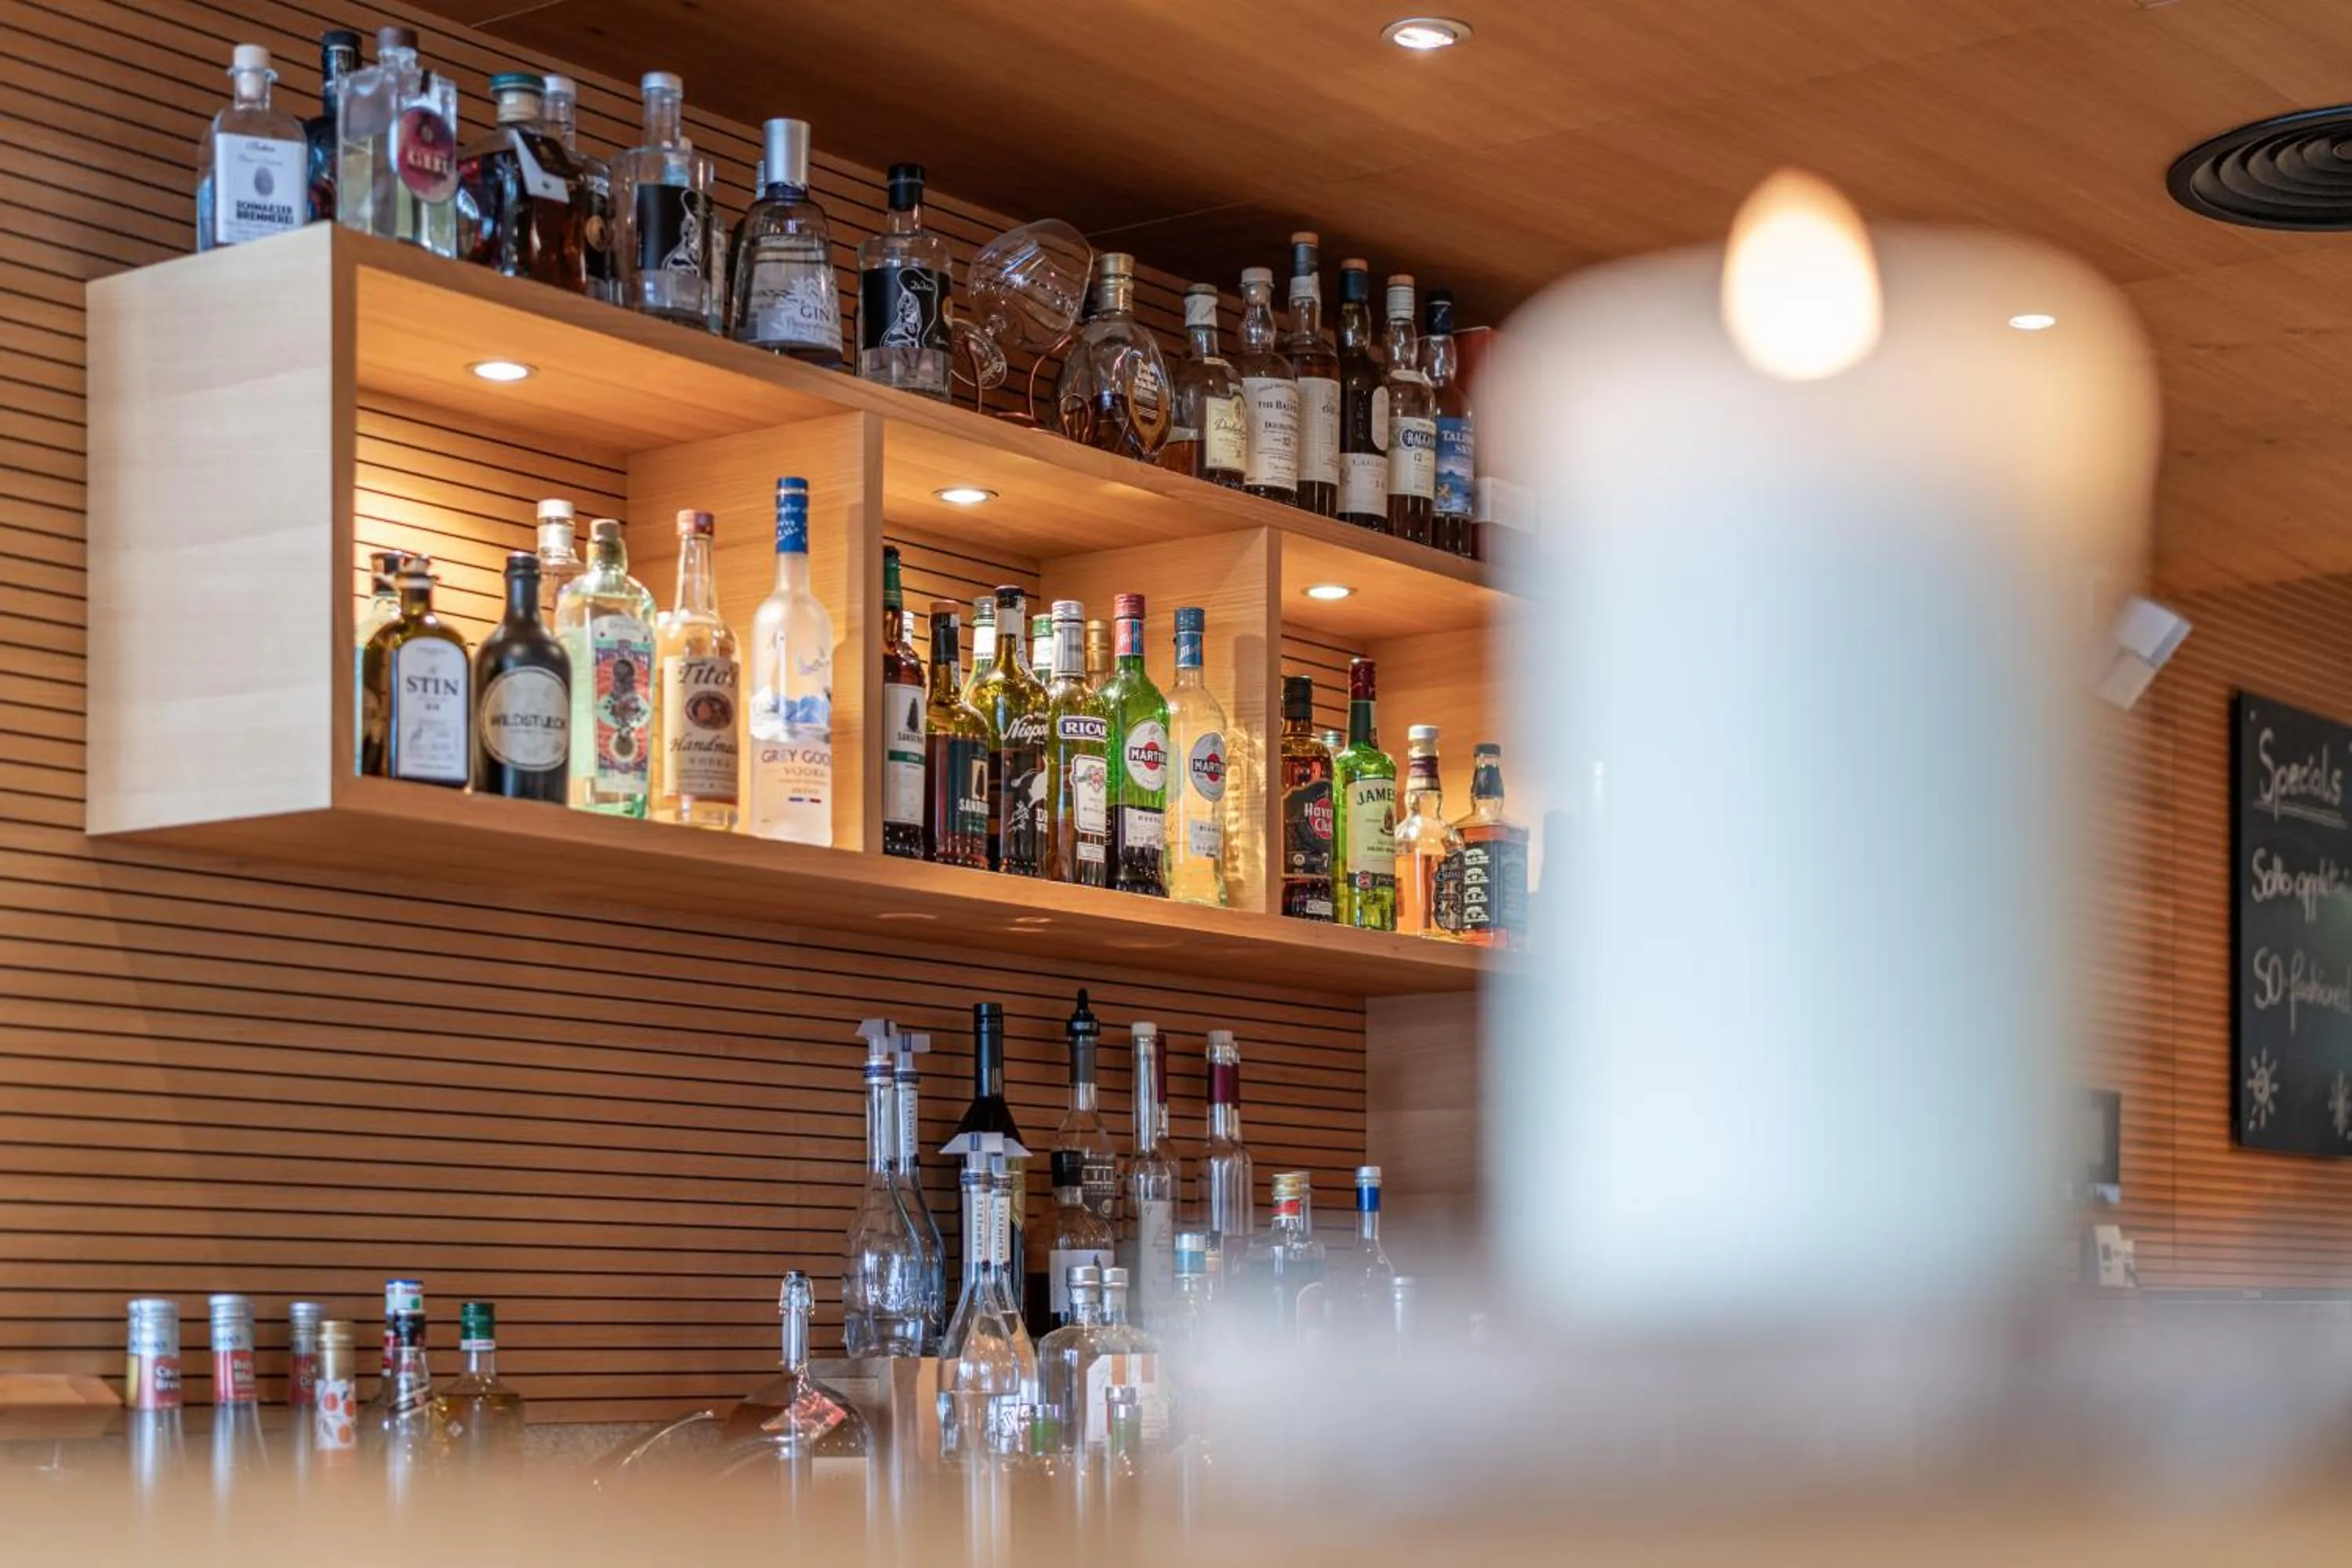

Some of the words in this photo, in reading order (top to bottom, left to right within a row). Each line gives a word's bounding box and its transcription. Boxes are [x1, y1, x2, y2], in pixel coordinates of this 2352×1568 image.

[800, 306, 840, 324] GIN
[677, 661, 738, 688] Tito's
[406, 675, 459, 696] STIN
[760, 749, 798, 764] GREY
[2259, 727, 2343, 822] Specials
